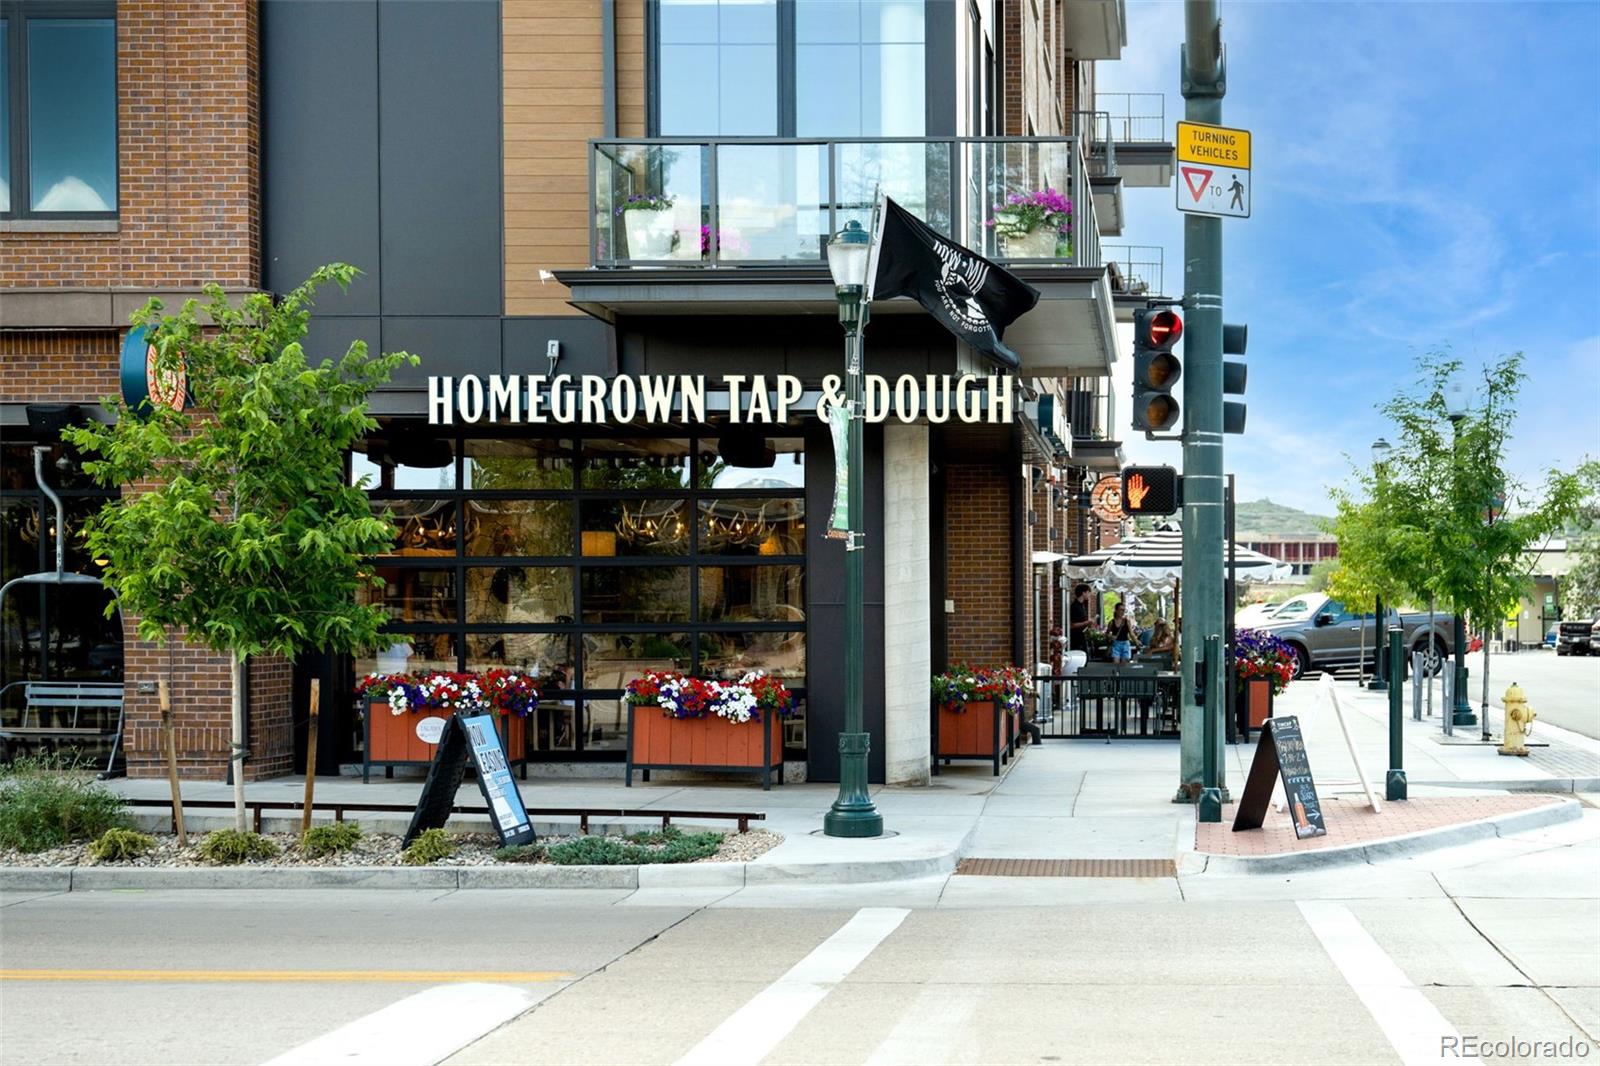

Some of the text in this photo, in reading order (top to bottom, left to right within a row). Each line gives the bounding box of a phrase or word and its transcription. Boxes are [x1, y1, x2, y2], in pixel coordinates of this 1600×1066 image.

[1192, 130, 1236, 146] TURNING
[1189, 144, 1239, 161] VEHICLES
[1210, 186, 1222, 197] TO
[949, 310, 960, 322] NOT
[427, 374, 1014, 425] HOMEGROWN TAP & DOUGH
